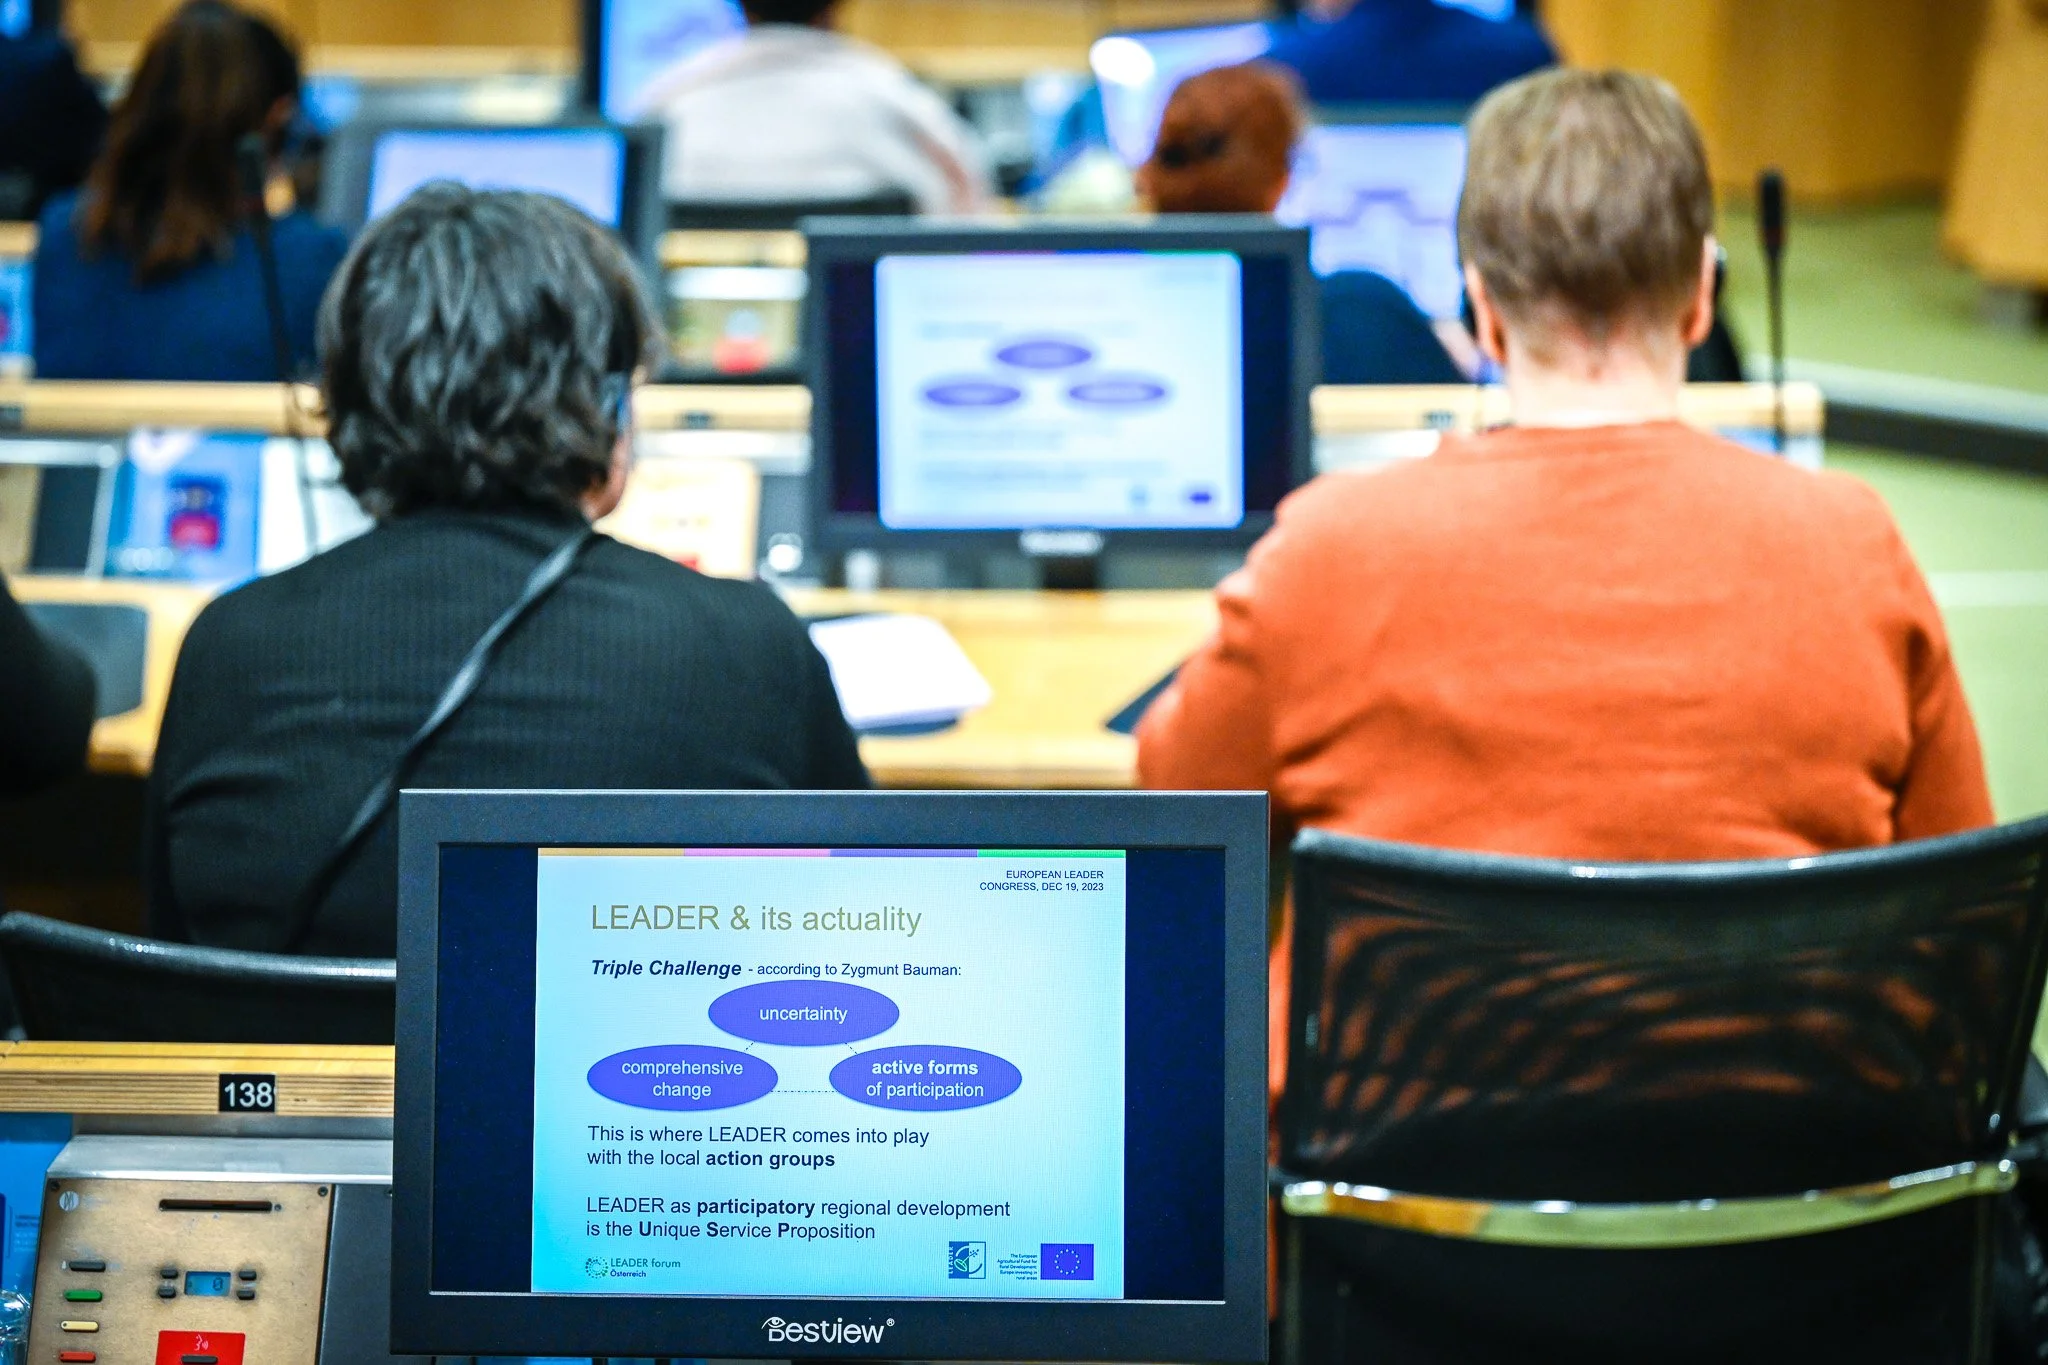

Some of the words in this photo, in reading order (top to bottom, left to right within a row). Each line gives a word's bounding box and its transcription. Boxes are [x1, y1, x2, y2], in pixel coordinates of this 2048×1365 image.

[1006, 869, 1062, 879] EUROPEAN
[1064, 869, 1104, 879] LEADER
[979, 881, 1039, 892] CONGRESS,
[1041, 881, 1063, 891] DEC
[1065, 881, 1080, 893] 19,
[1081, 881, 1104, 892] 2023
[592, 904, 720, 931] LEADER
[730, 904, 751, 931] &
[761, 904, 792, 931] its
[802, 905, 923, 938] actuality
[591, 958, 643, 980] Triple
[648, 959, 742, 980] Challenge
[757, 963, 821, 979] according
[824, 963, 838, 976] to
[841, 963, 899, 979] Zygmunt
[903, 963, 962, 976] Bauman:
[759, 1005, 848, 1025] uncertainty
[621, 1059, 744, 1079] comprehensive
[871, 1059, 924, 1075] active
[927, 1059, 979, 1076] forms
[224, 1081, 273, 1108] 138
[652, 1081, 712, 1101] change
[866, 1081, 883, 1097] of
[886, 1081, 984, 1101] participation
[587, 1125, 625, 1142] This
[630, 1125, 644, 1142] is
[648, 1125, 703, 1143] where
[709, 1126, 787, 1143] LEADER
[792, 1130, 851, 1144] comes
[856, 1127, 888, 1144] into
[893, 1127, 930, 1148] play
[586, 1148, 622, 1165] with
[627, 1149, 655, 1165] the
[660, 1149, 700, 1166] local
[705, 1150, 763, 1166] action
[769, 1154, 836, 1171] groups
[587, 1196, 665, 1214] LEADER
[670, 1201, 691, 1214] as
[697, 1198, 816, 1219] participatory
[821, 1199, 891, 1219] regional
[896, 1199, 1011, 1220] development
[586, 1220, 601, 1237] is
[605, 1220, 633, 1237] the
[639, 1220, 701, 1241] Unique
[706, 1221, 772, 1238] Service
[777, 1222, 875, 1243] Proposition
[610, 1258, 649, 1268] LEADER
[651, 1258, 681, 1268] forum
[609, 1269, 647, 1278] Österreich
